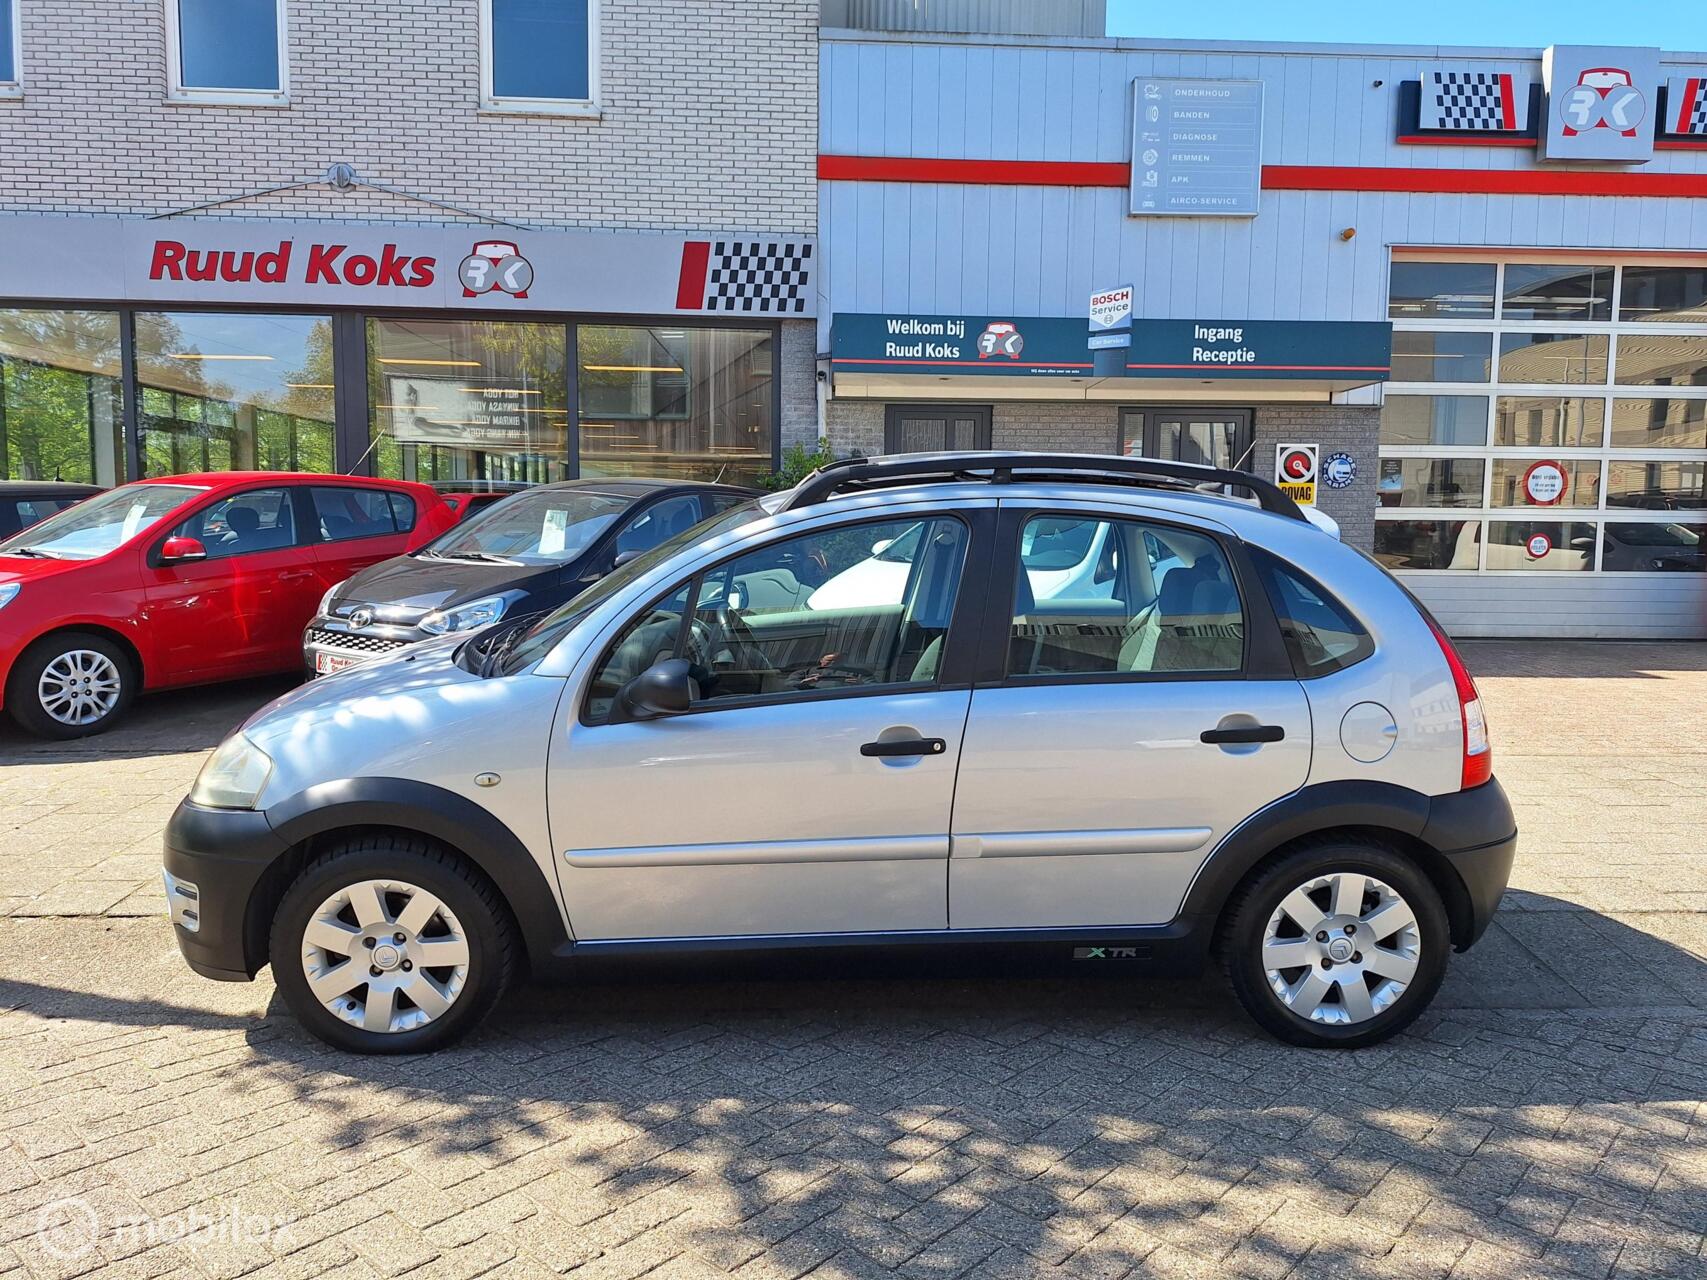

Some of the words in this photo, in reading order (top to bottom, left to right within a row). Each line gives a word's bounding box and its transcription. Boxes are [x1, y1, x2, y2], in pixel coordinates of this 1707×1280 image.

[1174, 88, 1231, 97] ONDERHOUD
[1173, 111, 1210, 119] BANDEN
[1172, 133, 1218, 141] DIAGNOSE
[1170, 197, 1238, 205] AIRCO-SERVICE
[149, 240, 293, 283] Ruud
[304, 244, 437, 287] Koks
[1092, 290, 1129, 306] BOSCH
[1091, 303, 1129, 316] Service
[886, 319, 944, 335] Welkom
[947, 320, 965, 338] bij
[1194, 324, 1243, 343] Ingang
[885, 342, 922, 358] Ruud
[925, 343, 960, 358] Koks
[1192, 347, 1256, 365] Receptie
[1323, 454, 1356, 469] SCHADE
[1087, 947, 1137, 958] XTR
